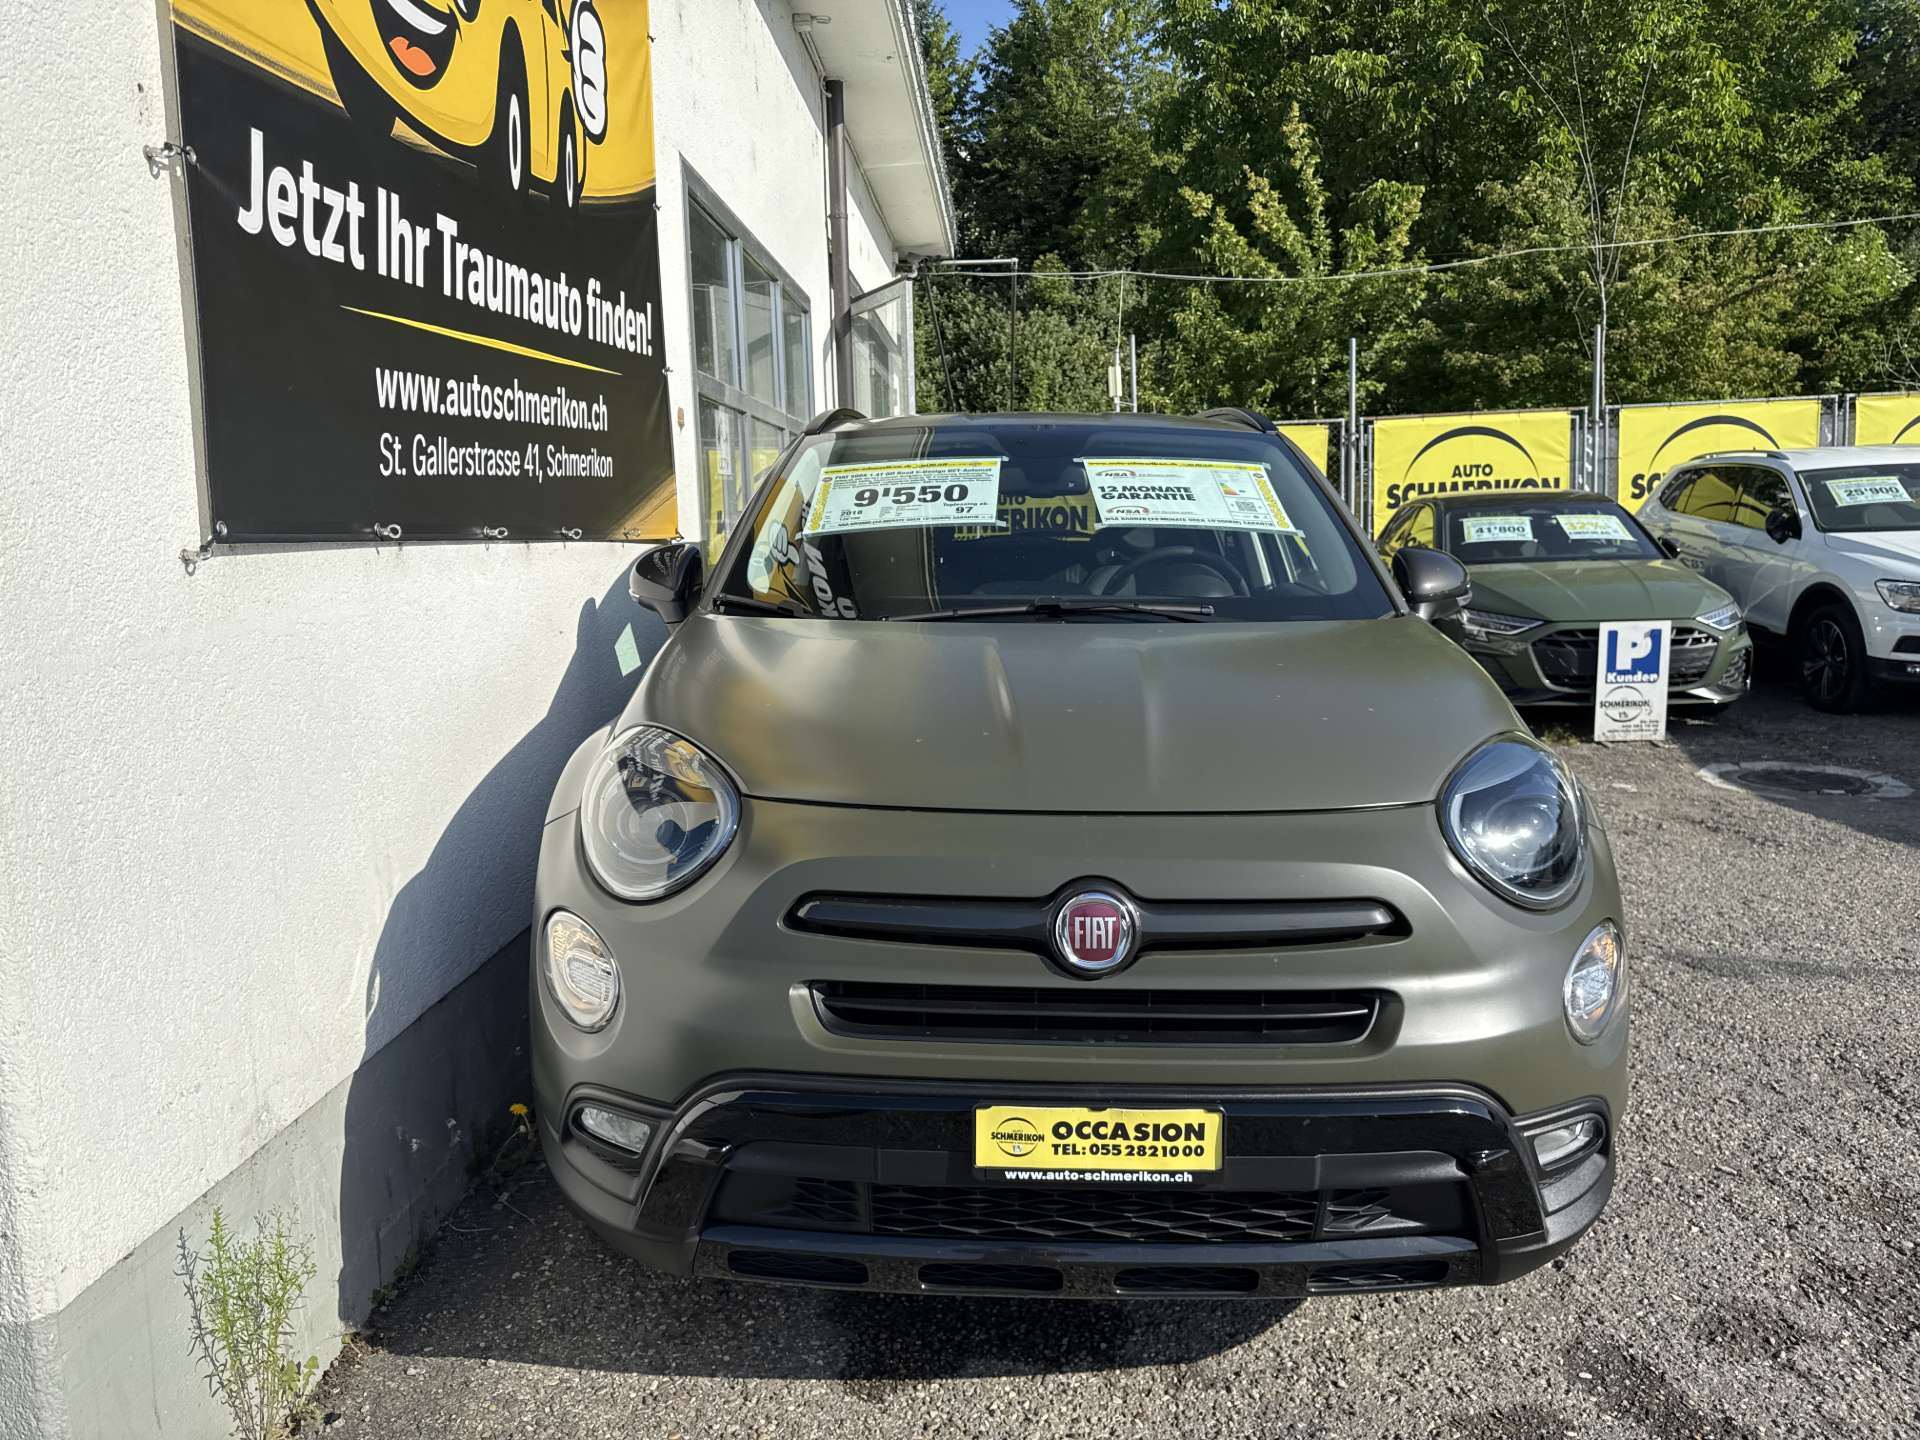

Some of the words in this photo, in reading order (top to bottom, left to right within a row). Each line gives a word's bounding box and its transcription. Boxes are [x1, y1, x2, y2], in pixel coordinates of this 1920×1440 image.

[237, 127, 365, 271] Jetzt
[376, 186, 431, 288] Ihr
[435, 212, 582, 337] Traumauto
[586, 277, 653, 357] finden!
[375, 367, 608, 432] www.autoschmerikon.ch
[379, 432, 406, 477] St.
[412, 433, 521, 478] Gallerstrasse
[524, 442, 543, 484] 41,
[546, 446, 614, 478] Schmerikon
[1451, 464, 1494, 478] AUTO
[853, 484, 969, 508] 9'550
[1098, 485, 1119, 493] 12
[1121, 486, 1193, 494] MONATE
[1843, 486, 1900, 497] 25'900
[998, 493, 1026, 506] UTO
[1101, 493, 1196, 501] GARANTIE
[955, 506, 974, 515] 97
[1475, 526, 1526, 534] 41'800
[1606, 670, 1659, 683] Kunden
[1074, 916, 1117, 949] FIAT
[991, 1131, 1045, 1142] SCHMERIKON
[1051, 1120, 1206, 1142] OCCASION
[1051, 1143, 1087, 1156] TEL:
[1089, 1144, 1122, 1157] 055
[1125, 1144, 1158, 1157] 282
[1005, 1169, 1193, 1182] www.auto-schmerikon.ch
